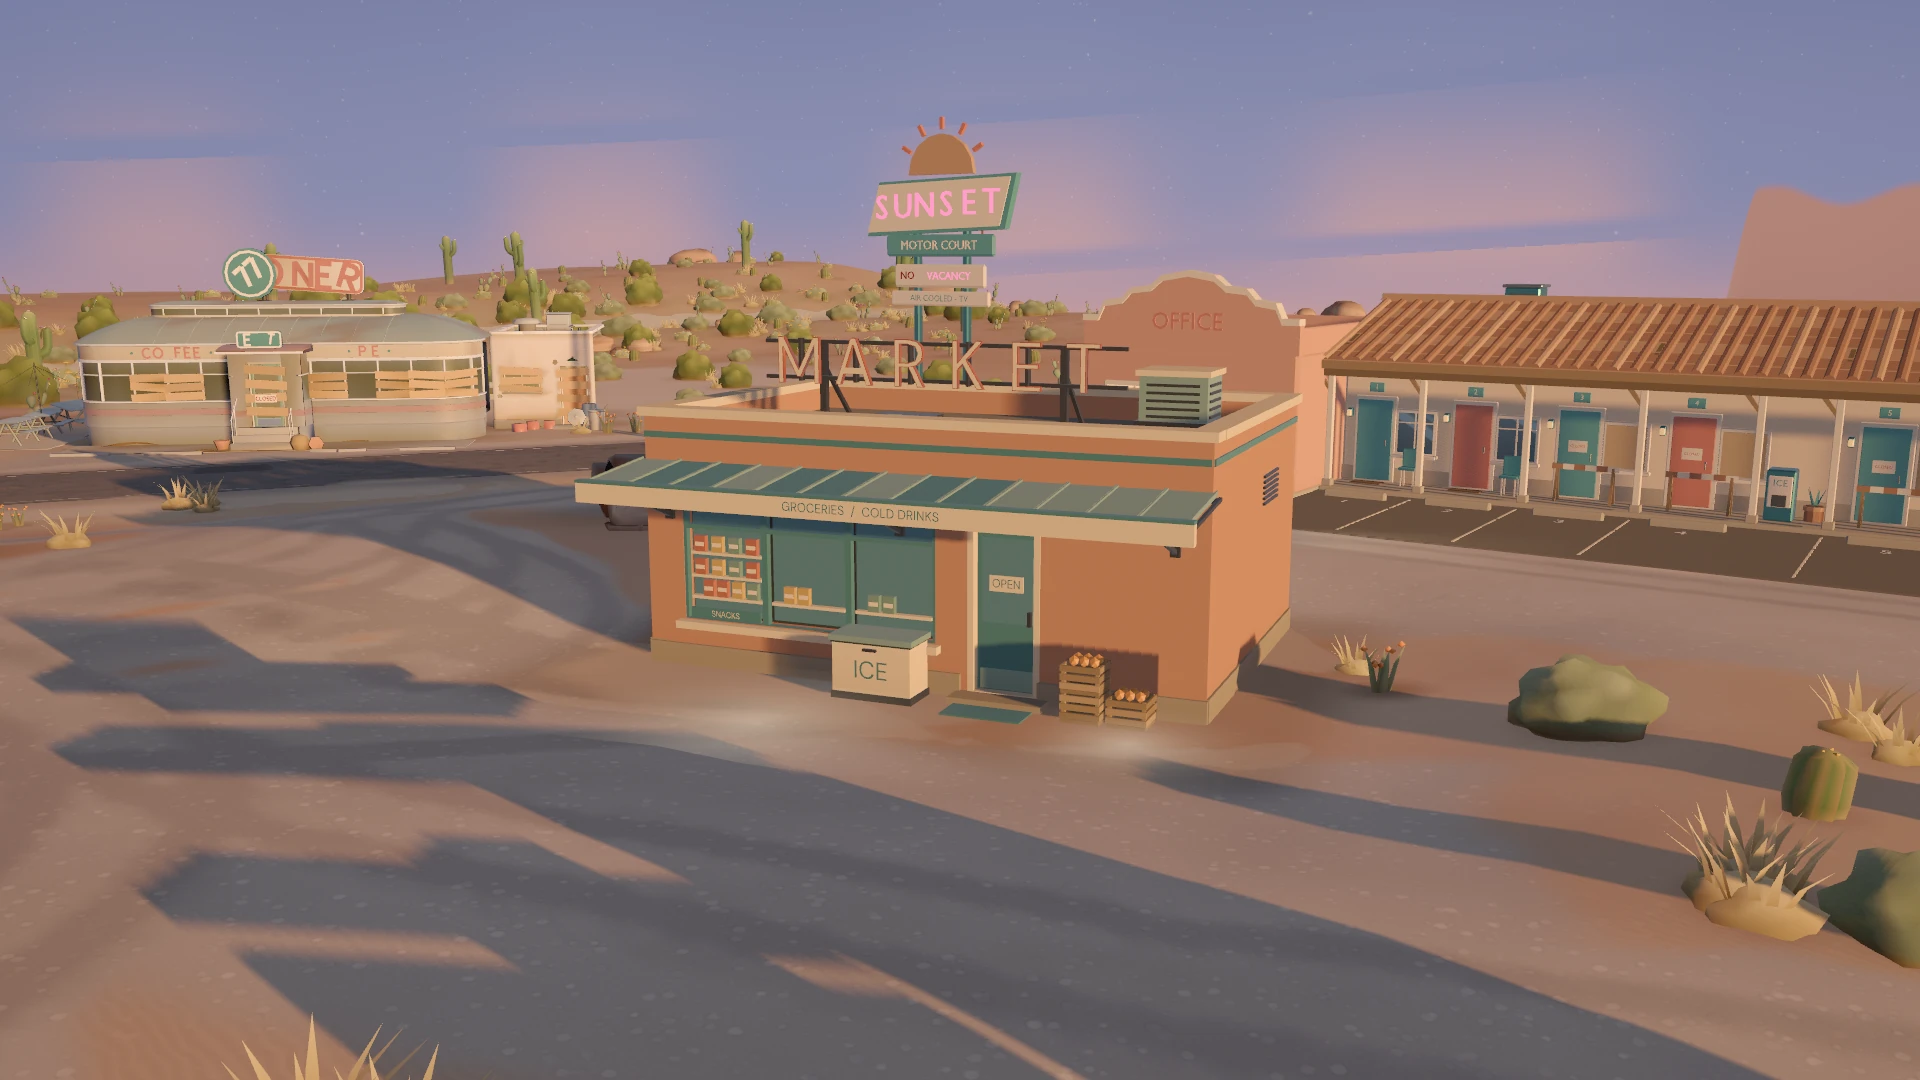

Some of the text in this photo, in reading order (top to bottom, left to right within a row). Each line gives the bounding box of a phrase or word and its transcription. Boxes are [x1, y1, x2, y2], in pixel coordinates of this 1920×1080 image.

[875, 187, 1001, 220] SUNSET
[900, 239, 978, 251] MOTOR COURT
[231, 256, 263, 288] 77
[900, 271, 971, 280] NO VACANCY
[910, 294, 921, 302] AIR
[922, 294, 953, 303] COOLED
[1152, 311, 1224, 332] OFFICE
[778, 335, 1102, 394] MARKET
[1473, 388, 1479, 397] 2
[1773, 479, 1789, 488] ICE
[781, 501, 844, 516] GROCERIES
[861, 507, 895, 519] COLD
[897, 509, 939, 523] DRINKS
[992, 578, 1020, 590] OPEN
[711, 609, 740, 620] SNACKS
[854, 659, 887, 682] ICE
